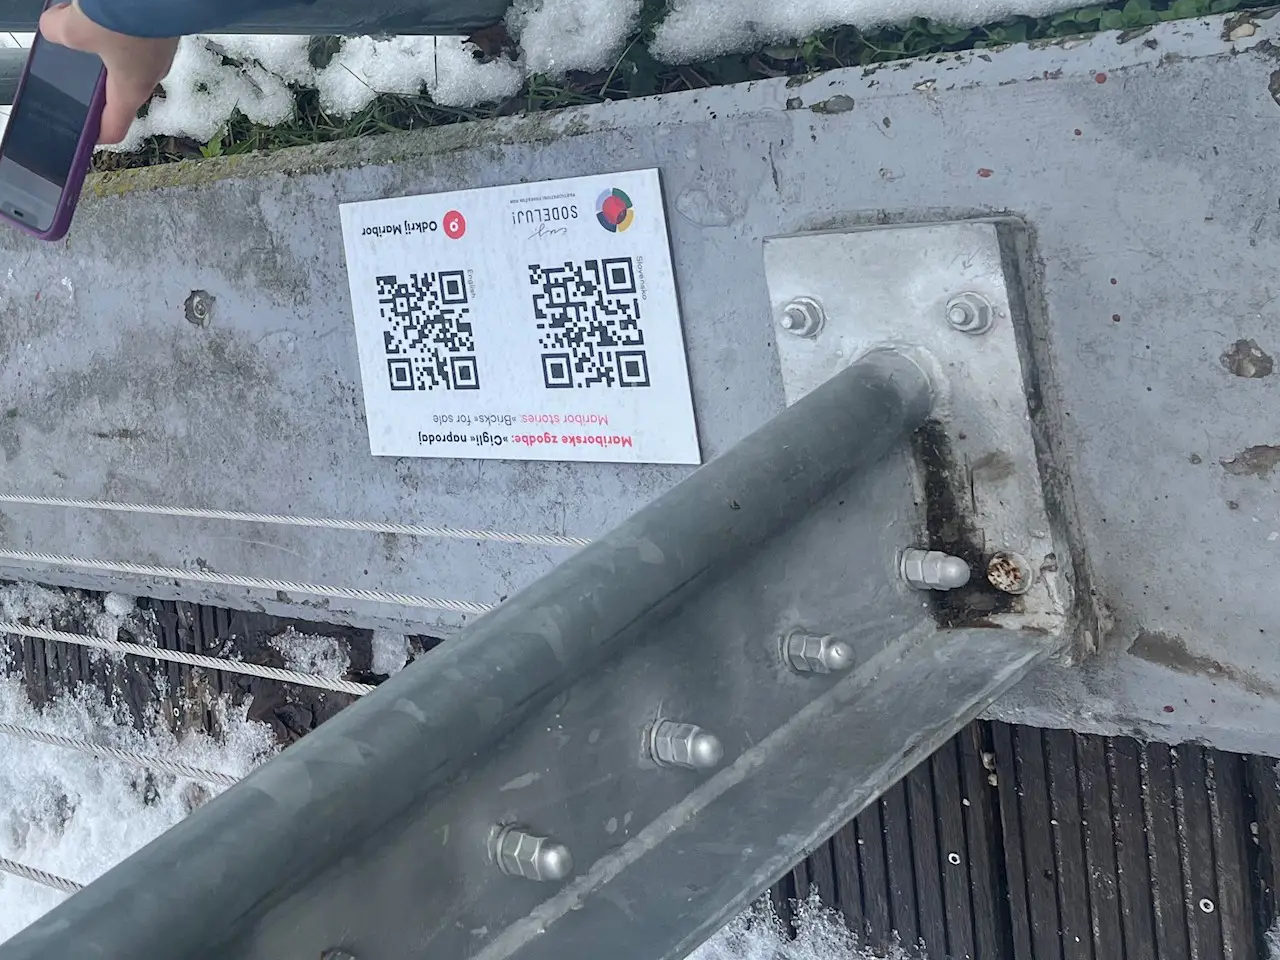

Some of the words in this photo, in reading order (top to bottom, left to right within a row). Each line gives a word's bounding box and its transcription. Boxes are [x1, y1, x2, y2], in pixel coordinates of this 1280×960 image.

[512, 205, 578, 225] SODELUJ!
[362, 225, 402, 237] Maribor
[404, 220, 438, 235] Odkrij
[467, 269, 476, 298] English
[636, 255, 647, 300] Slovensko
[433, 414, 454, 425] sale
[456, 414, 471, 426] for
[563, 414, 609, 426] Maribor
[418, 431, 467, 446] naprodaj
[511, 431, 558, 447] zgodbe:
[562, 434, 632, 447] Mariborske
